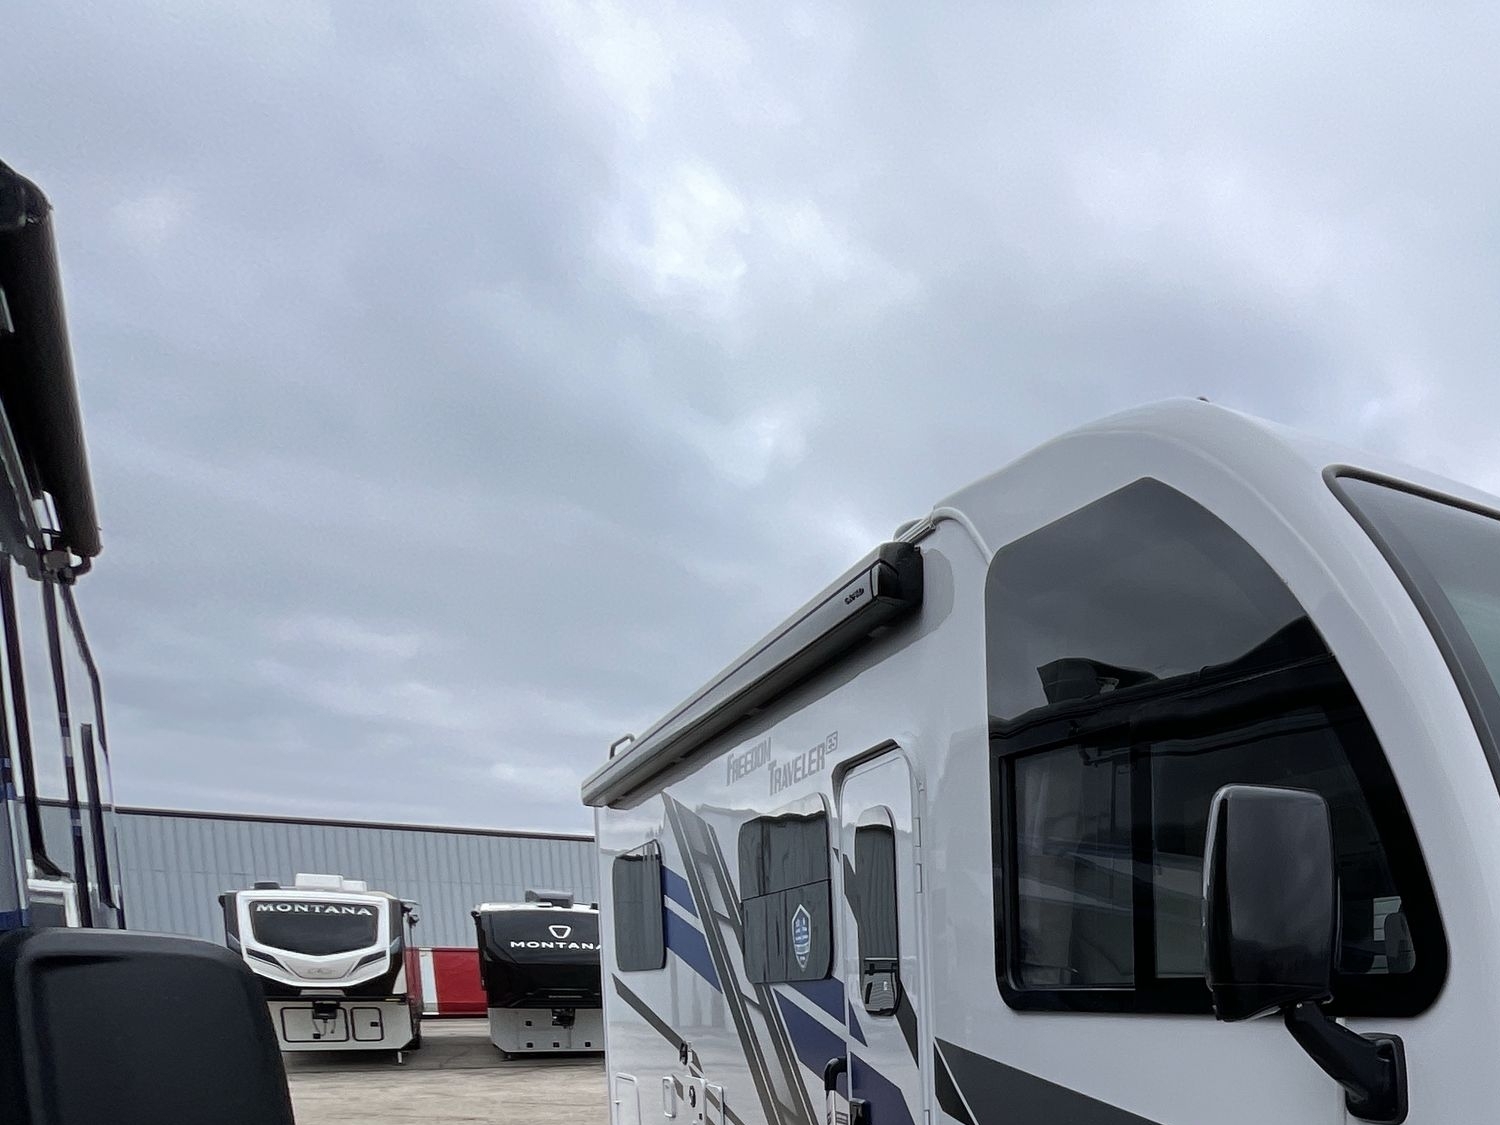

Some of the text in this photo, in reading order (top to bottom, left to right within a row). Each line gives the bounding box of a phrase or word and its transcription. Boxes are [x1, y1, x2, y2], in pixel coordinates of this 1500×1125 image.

[726, 736, 772, 787] FREEDOM
[768, 741, 826, 796] TRAVELER
[256, 903, 373, 916] MONTANA
